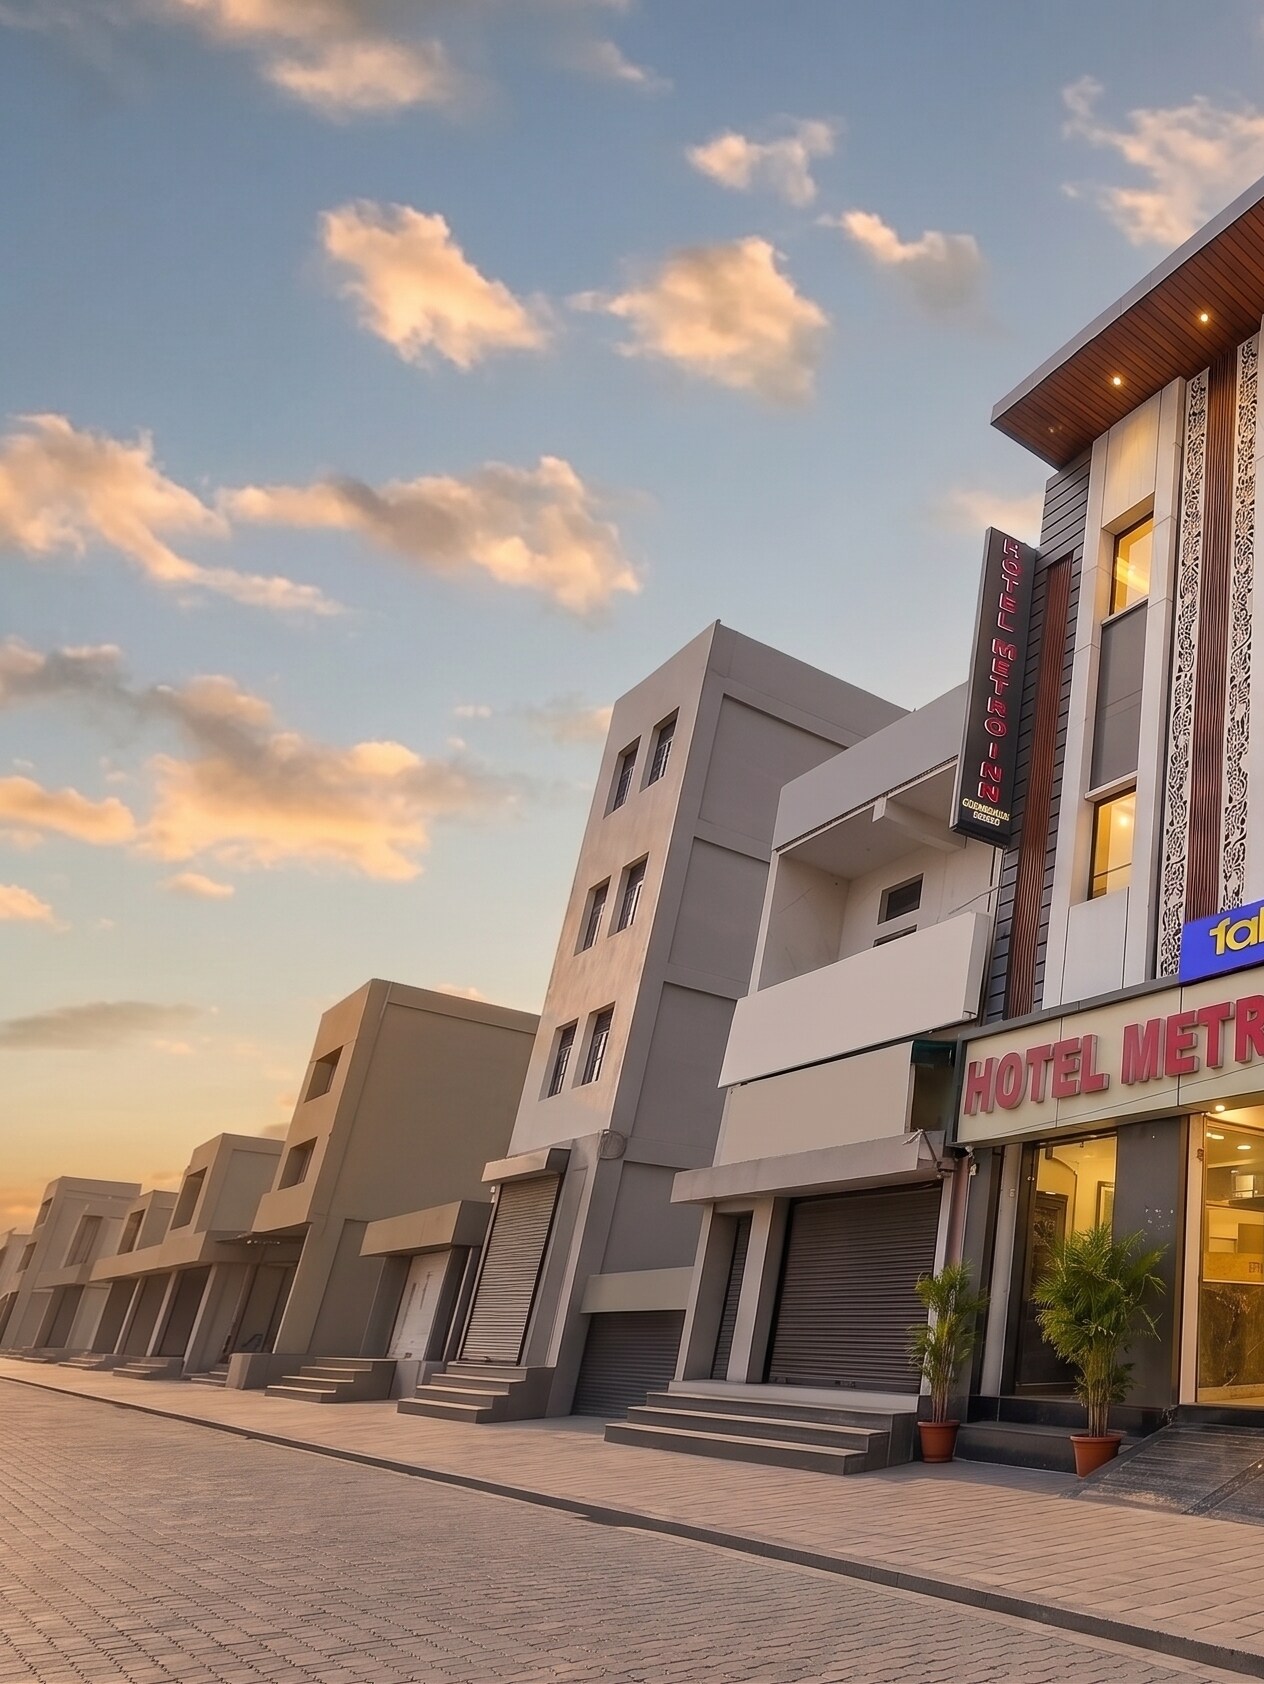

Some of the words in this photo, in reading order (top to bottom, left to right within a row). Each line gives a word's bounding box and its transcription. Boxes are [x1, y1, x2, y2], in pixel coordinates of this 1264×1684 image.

[998, 538, 1023, 633] HOTEL
[983, 637, 1017, 737] METRO
[977, 741, 1003, 804] INN
[962, 1034, 1109, 1116] HOTEL
